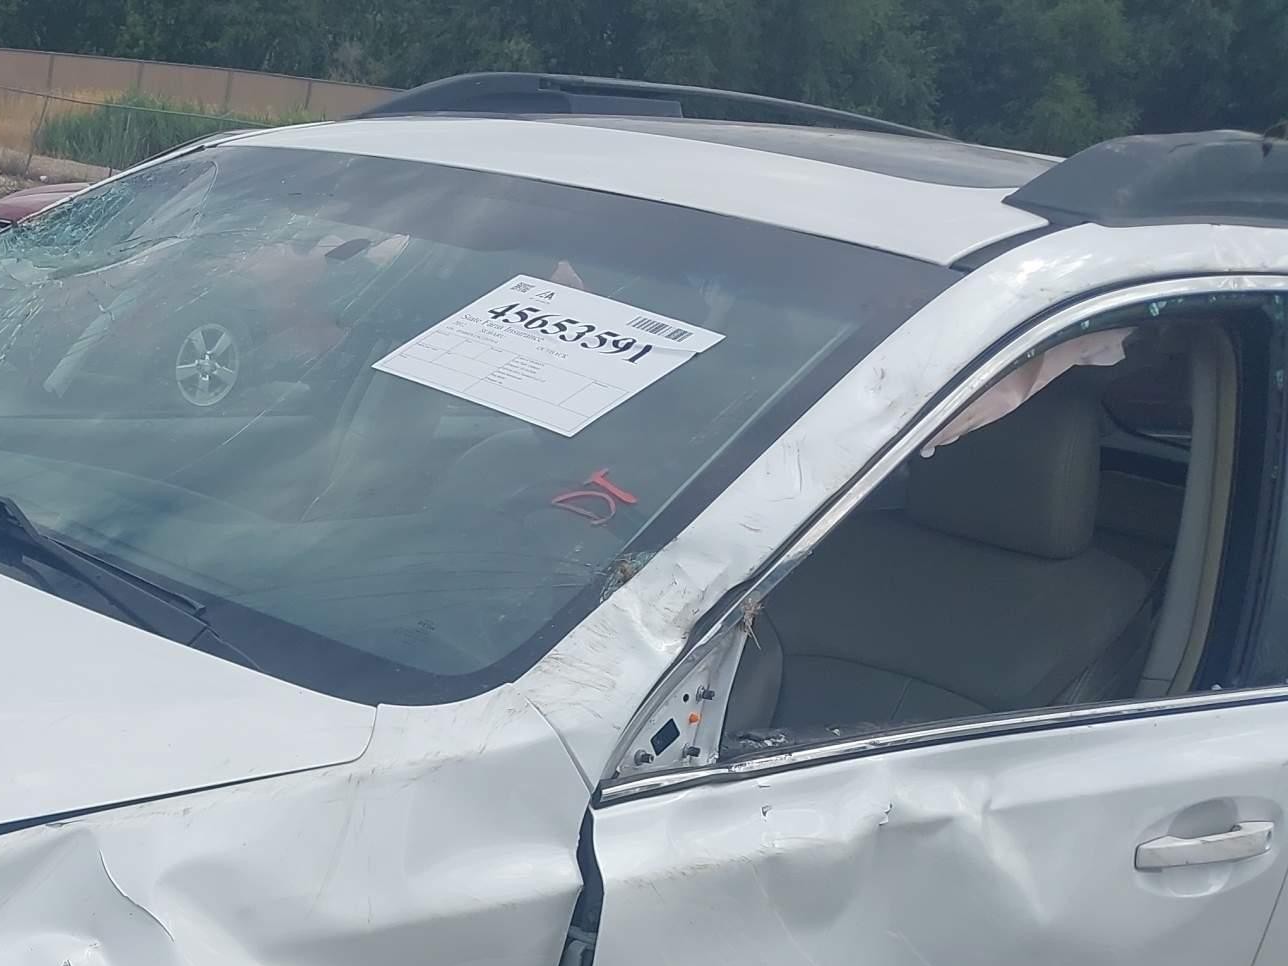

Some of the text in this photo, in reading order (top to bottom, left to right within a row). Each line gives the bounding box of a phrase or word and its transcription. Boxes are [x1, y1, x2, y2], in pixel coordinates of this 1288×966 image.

[462, 313, 482, 324] State
[481, 319, 504, 331] Farm
[503, 326, 545, 342] Insurance
[488, 303, 653, 364] 45653591
